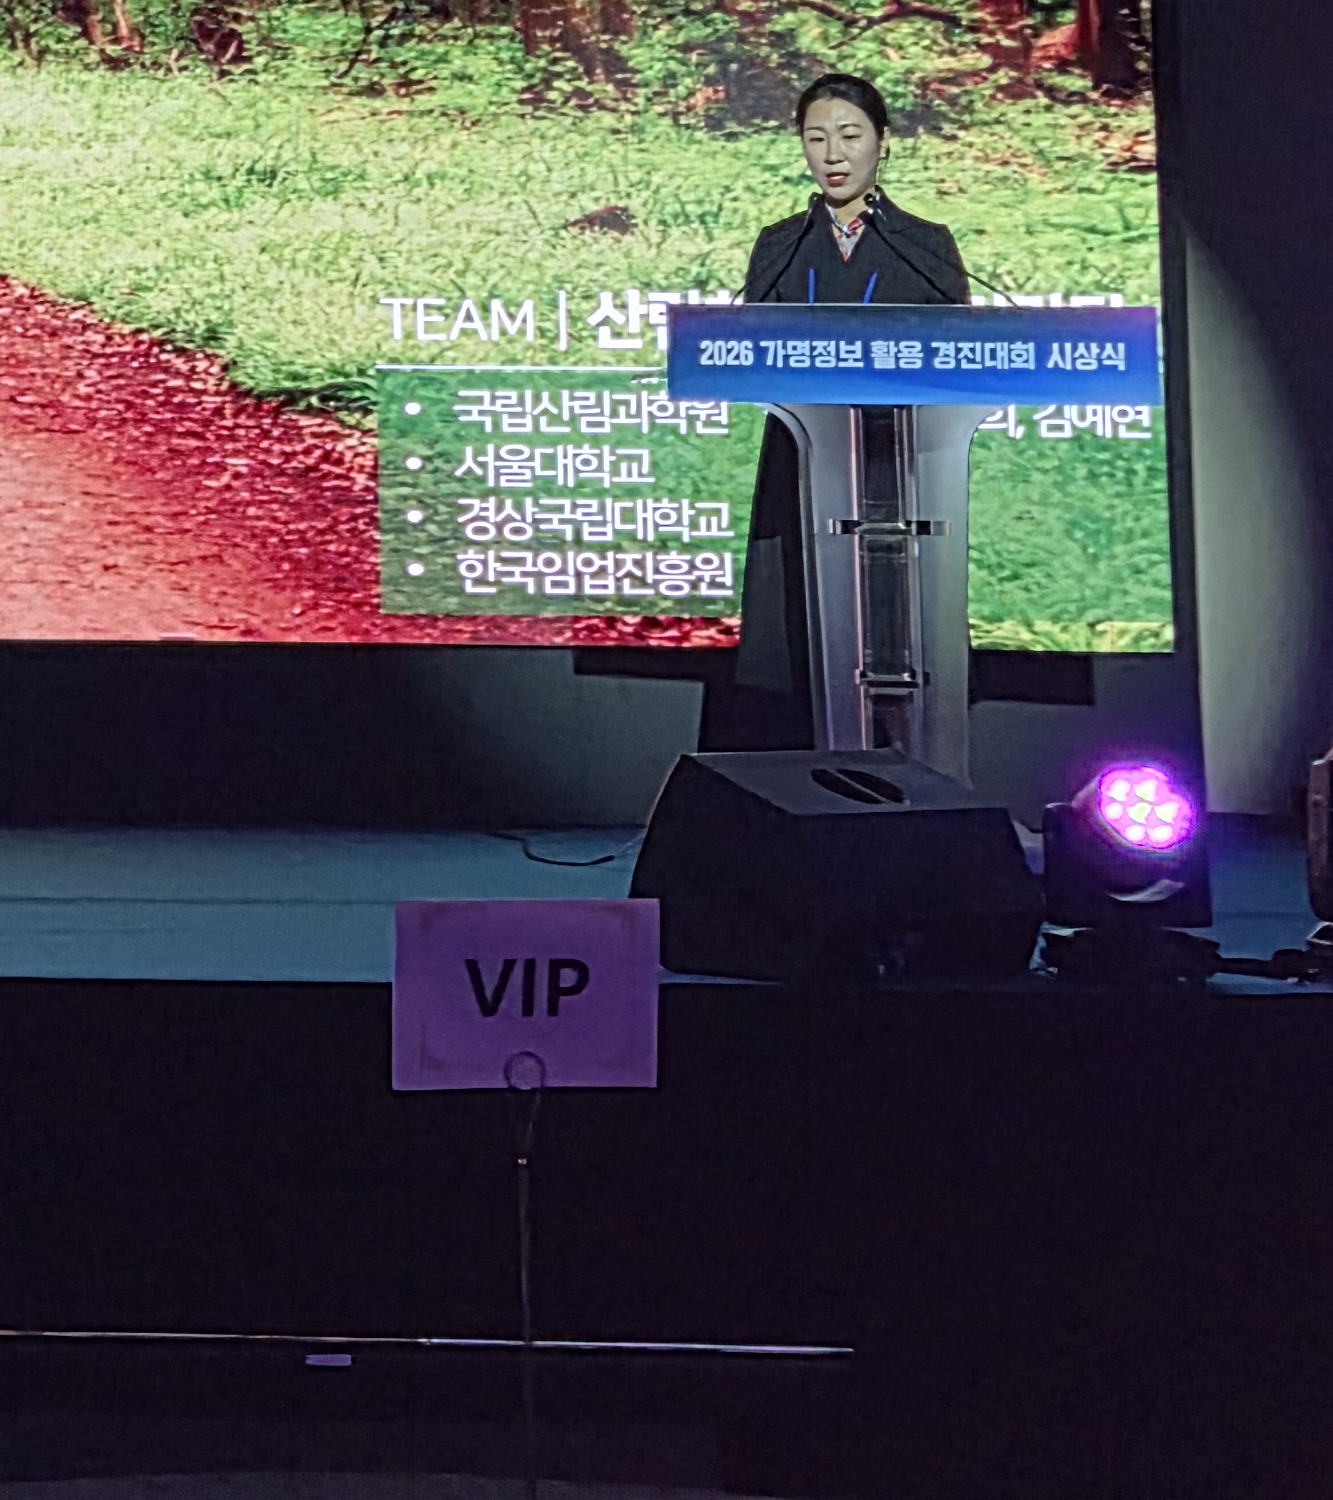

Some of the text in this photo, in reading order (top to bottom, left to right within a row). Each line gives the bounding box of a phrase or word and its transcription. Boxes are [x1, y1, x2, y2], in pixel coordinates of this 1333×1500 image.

[379, 297, 535, 342] TEAM
[699, 339, 1127, 371] 2026 가명정보 활용 경진대회 시상식
[452, 388, 730, 435] 국립산림과학원
[453, 443, 656, 488] 서울대학교
[456, 496, 735, 542] 경상국립대학교
[456, 549, 734, 597] 한국임업진흥원
[464, 958, 590, 1018] VIP
